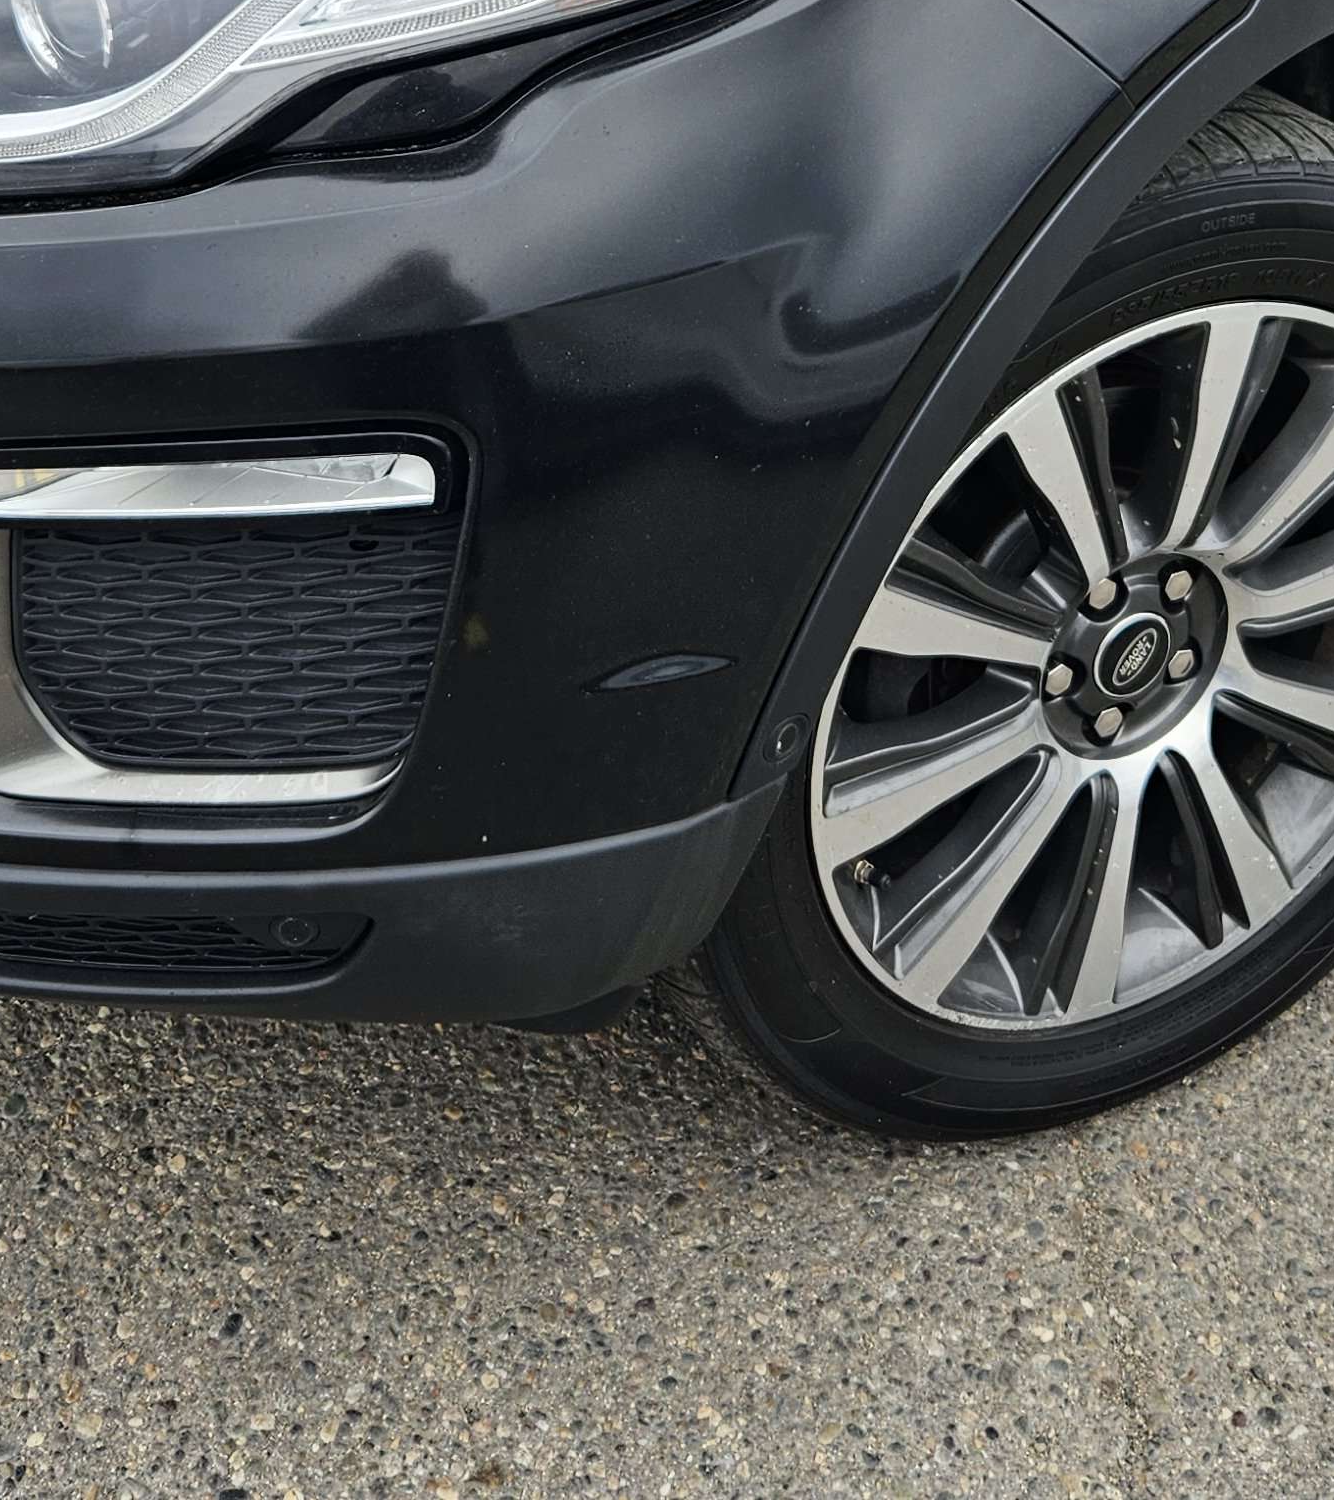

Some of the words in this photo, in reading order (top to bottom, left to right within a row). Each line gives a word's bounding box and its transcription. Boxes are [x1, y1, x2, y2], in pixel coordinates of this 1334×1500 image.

[1202, 212, 1256, 233] OUTSIDE
[1119, 640, 1144, 675] ROVER
[1130, 641, 1152, 670] LAND
